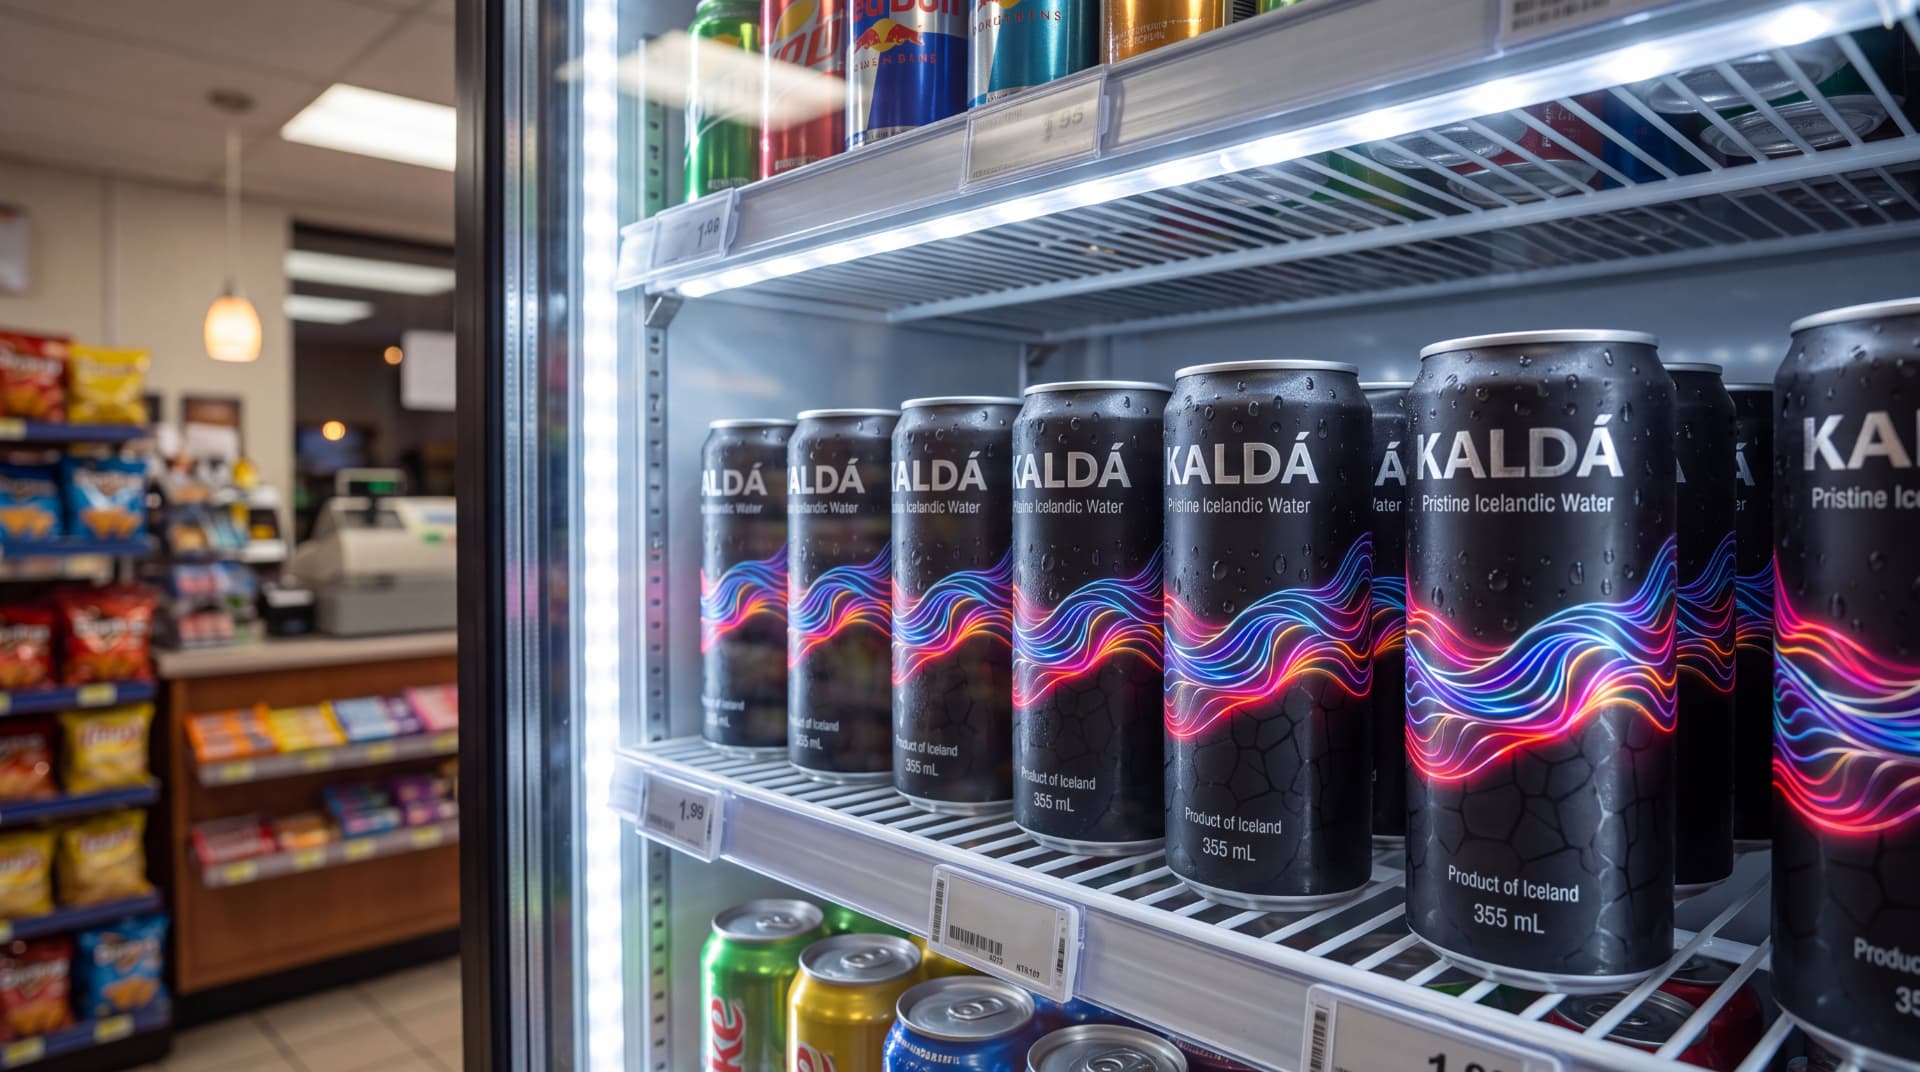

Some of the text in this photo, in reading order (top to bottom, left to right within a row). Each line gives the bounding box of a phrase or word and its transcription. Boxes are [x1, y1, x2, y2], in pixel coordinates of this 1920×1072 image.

[1416, 413, 1625, 480] KALDÁ
[1803, 406, 1920, 472] KA
[1012, 442, 1133, 489] KALDÁ
[1166, 431, 1320, 486] KALDÁ
[787, 457, 866, 495] ALDÁ
[906, 500, 945, 514] Icelandic
[947, 500, 981, 514] Water
[1035, 499, 1083, 514] Icelandic
[1086, 499, 1125, 514] Water
[1203, 497, 1264, 514] Icelandic
[1268, 497, 1311, 514] Water
[1373, 499, 1402, 512] ater
[1422, 492, 1614, 513] Pristine Icelandic Water
[1811, 485, 1888, 510] Pristine
[927, 741, 959, 757] Iceland
[905, 758, 940, 777] 355 mL
[1048, 773, 1059, 787] of
[1060, 774, 1096, 791] Iceland
[680, 798, 704, 821] 1.99
[1033, 791, 1075, 812] 355 mL
[1185, 806, 1282, 834] Product of Iceland
[1202, 837, 1257, 862] 355 mL
[1449, 864, 1579, 903] Product of Iceland
[1473, 903, 1545, 934] 355 mL
